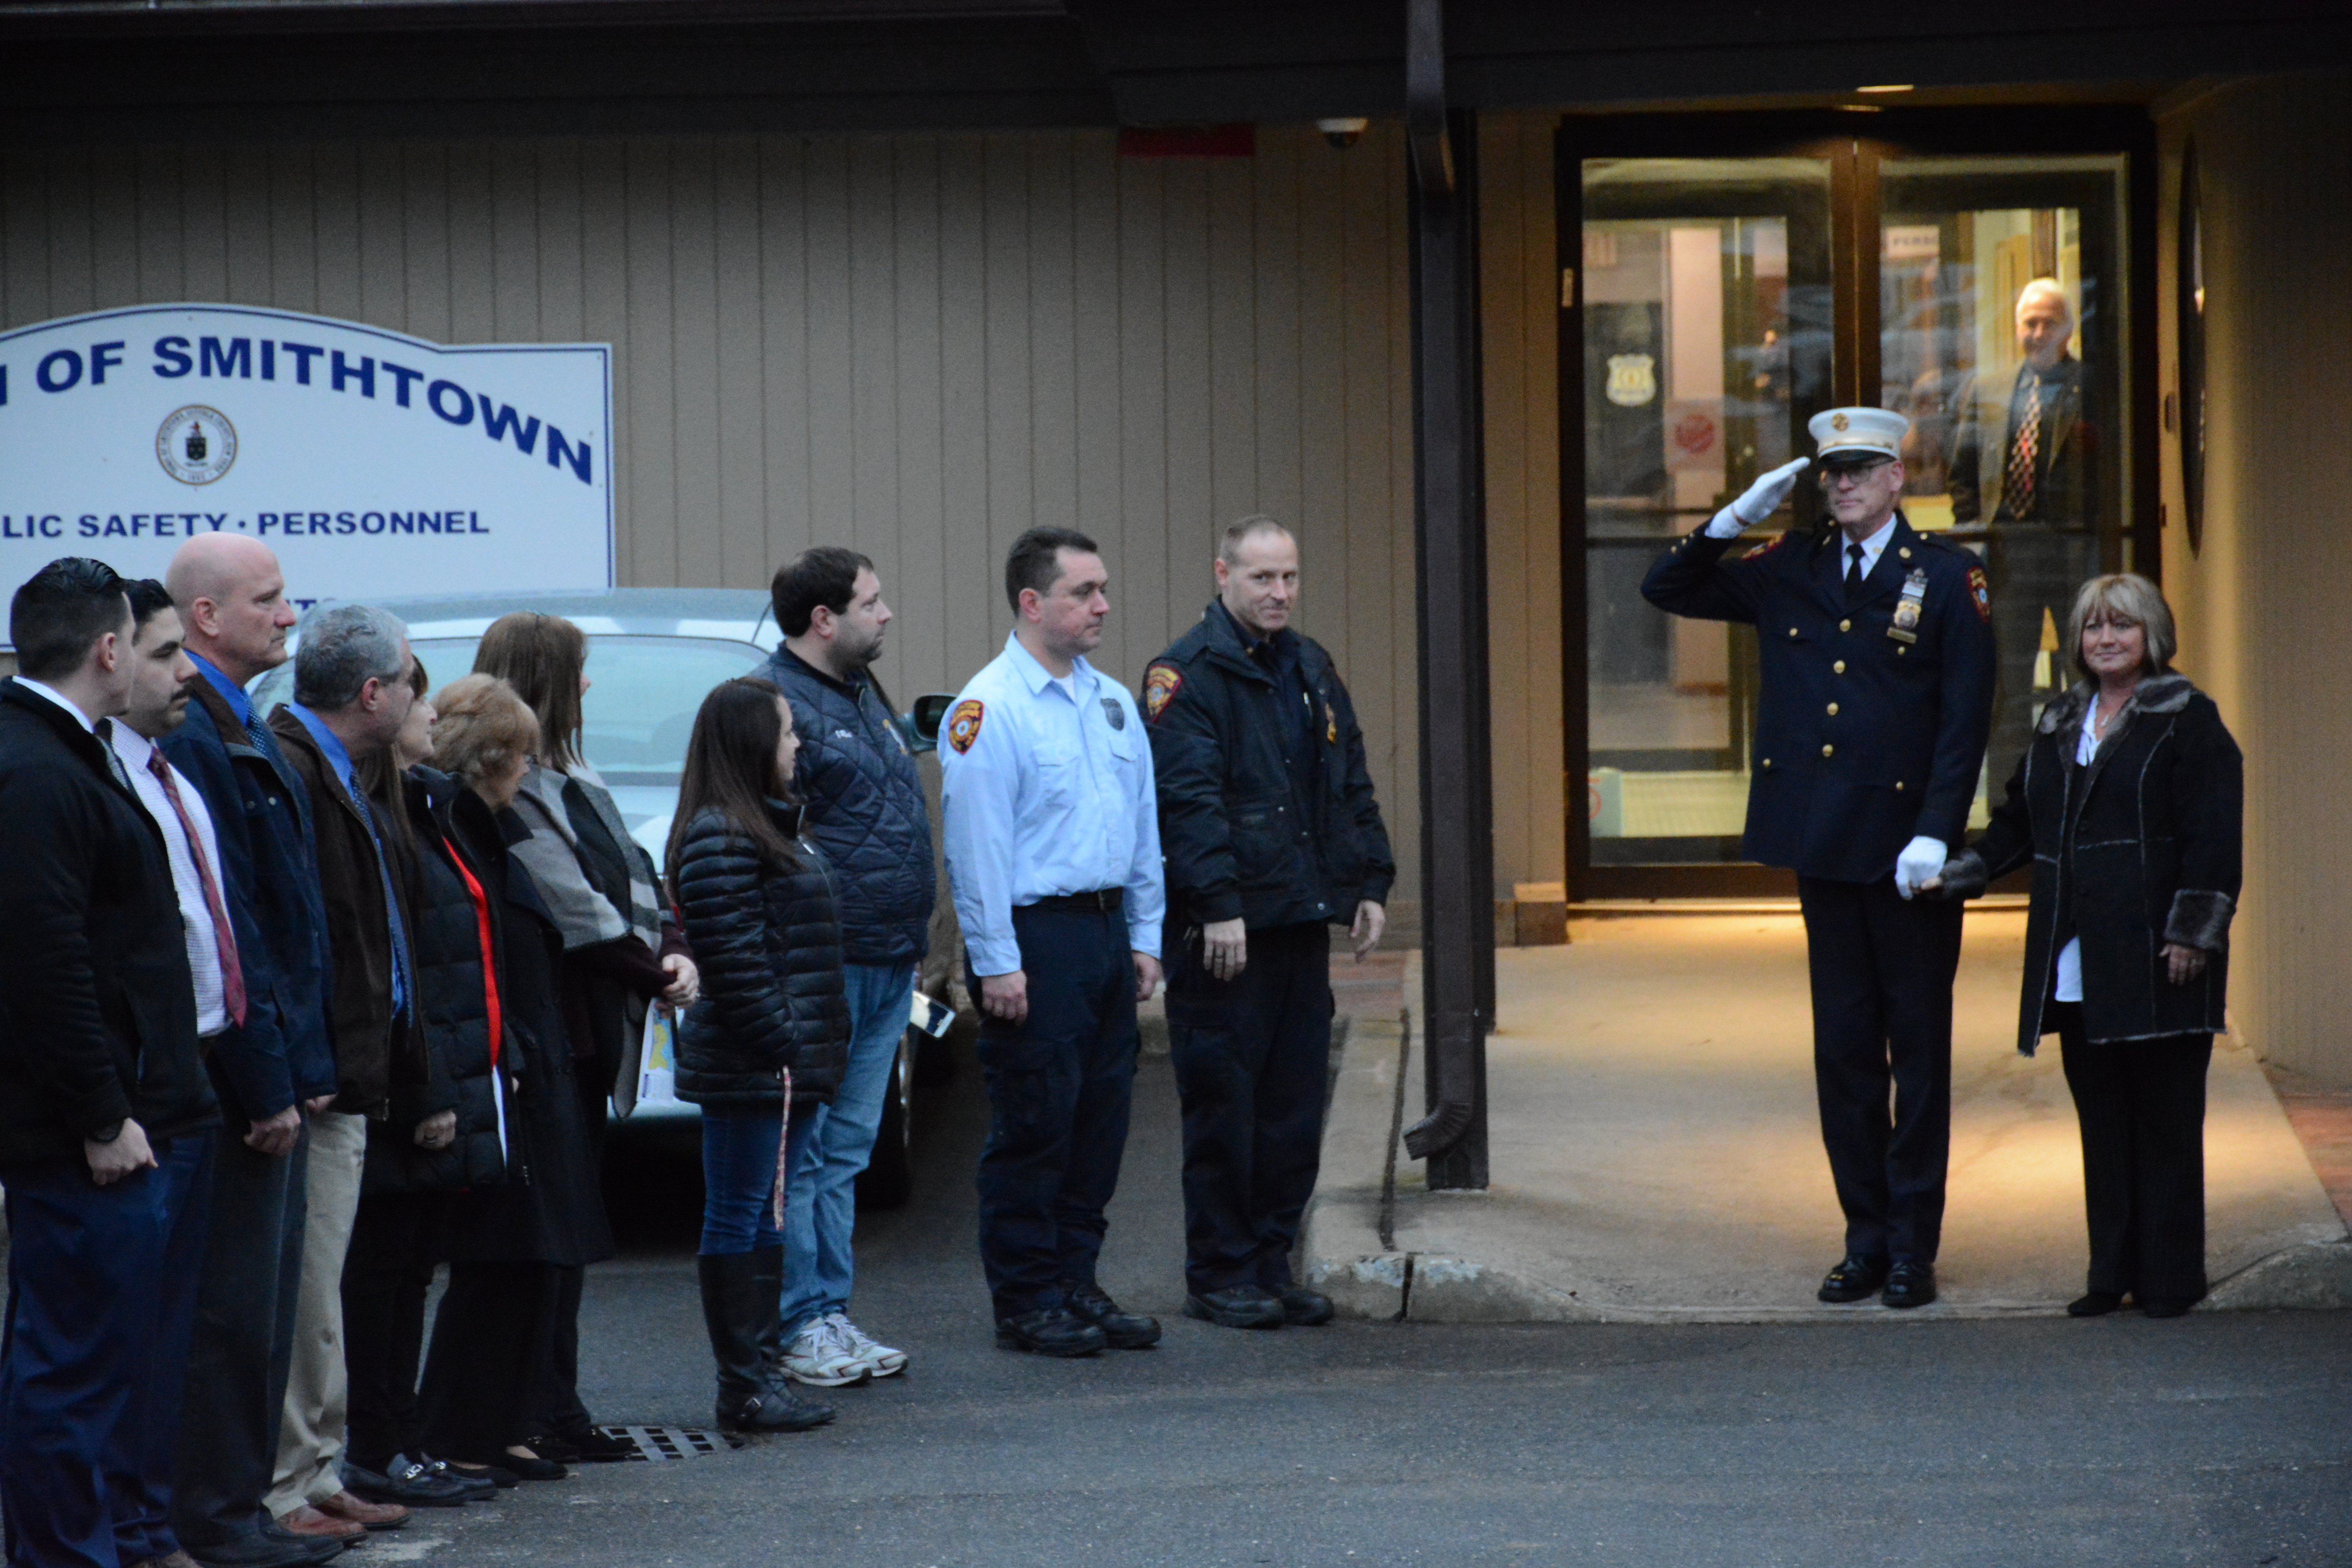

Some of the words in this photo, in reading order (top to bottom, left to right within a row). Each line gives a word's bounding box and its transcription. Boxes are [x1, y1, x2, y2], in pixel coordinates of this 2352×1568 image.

[35, 341, 126, 394] OF
[152, 335, 592, 486] SMITHTOWN
[3, 515, 62, 539] LIC
[78, 514, 227, 538] SAFETY
[258, 512, 489, 535] PERSONNEL
